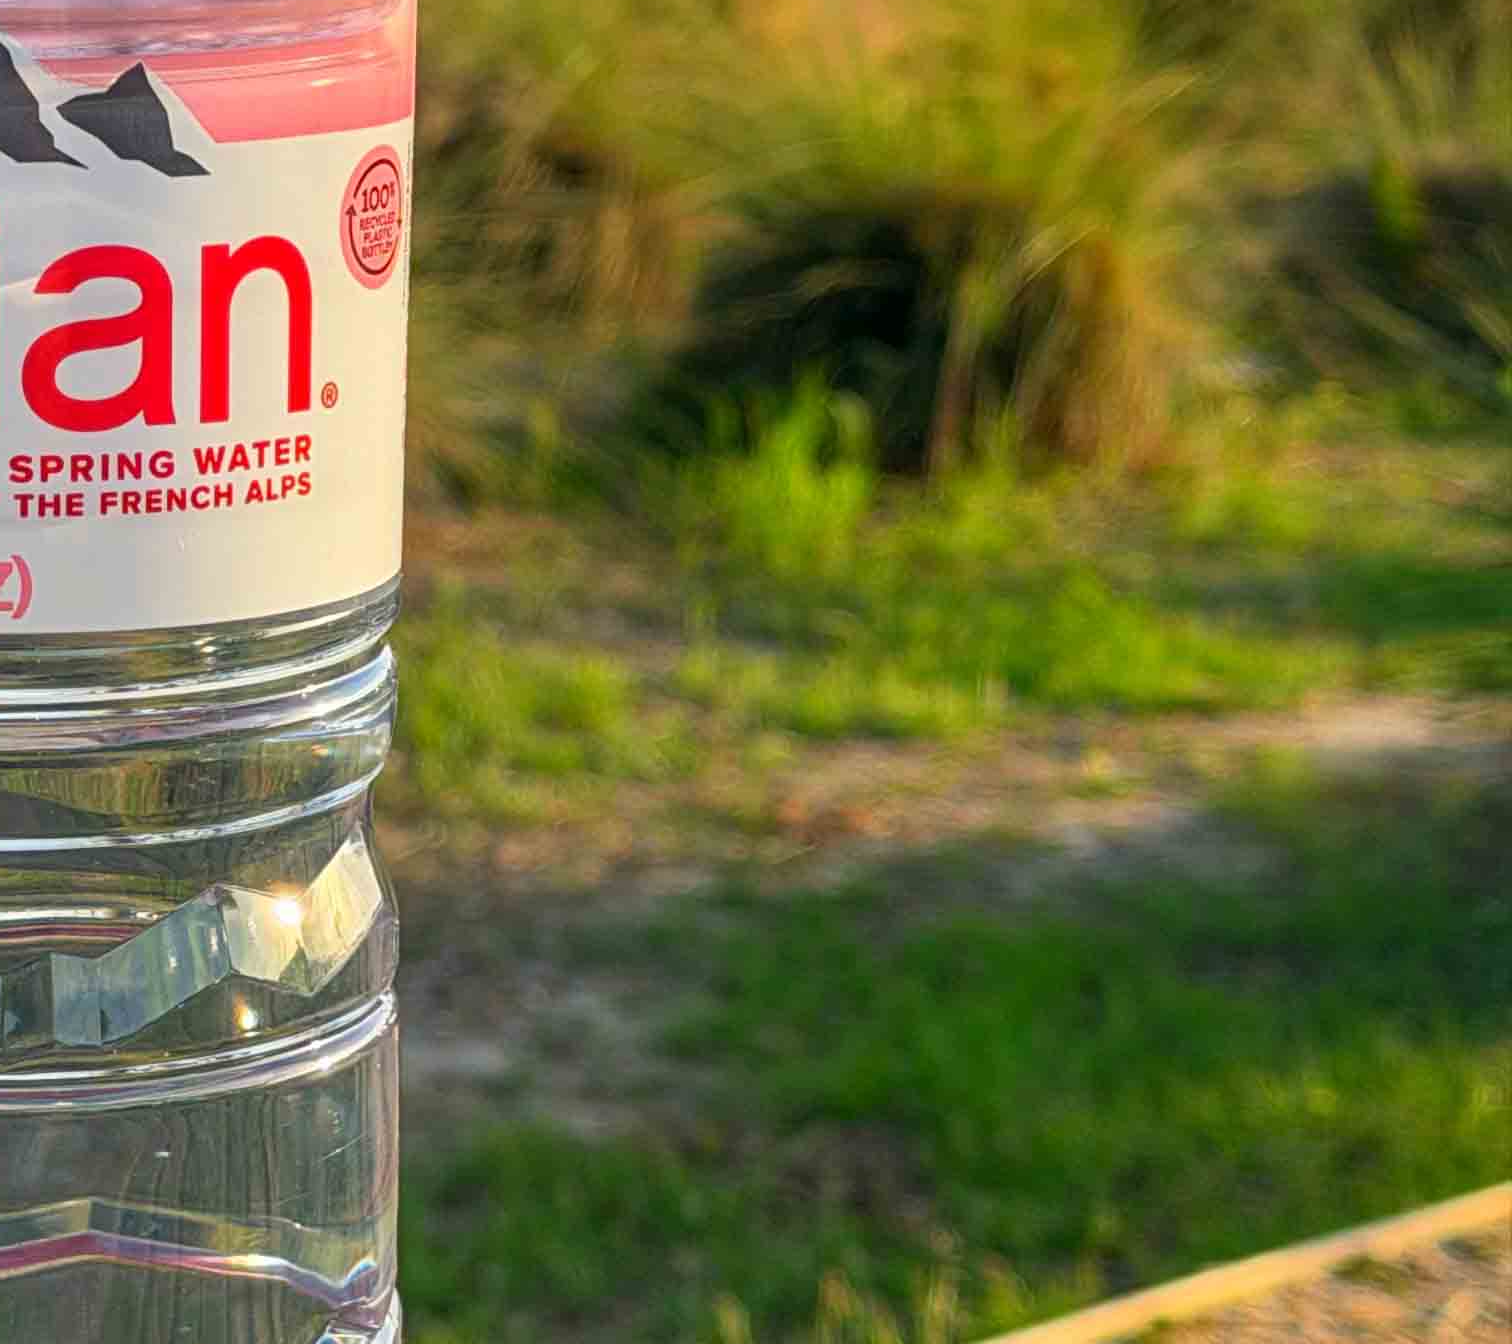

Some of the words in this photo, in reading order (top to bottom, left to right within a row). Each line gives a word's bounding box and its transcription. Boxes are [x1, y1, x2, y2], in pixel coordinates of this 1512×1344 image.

[8, 449, 175, 483] SPRING
[193, 434, 312, 475] WATER
[15, 492, 83, 518] THE
[99, 485, 234, 514] FRENCH
[245, 477, 312, 504] ALPS
